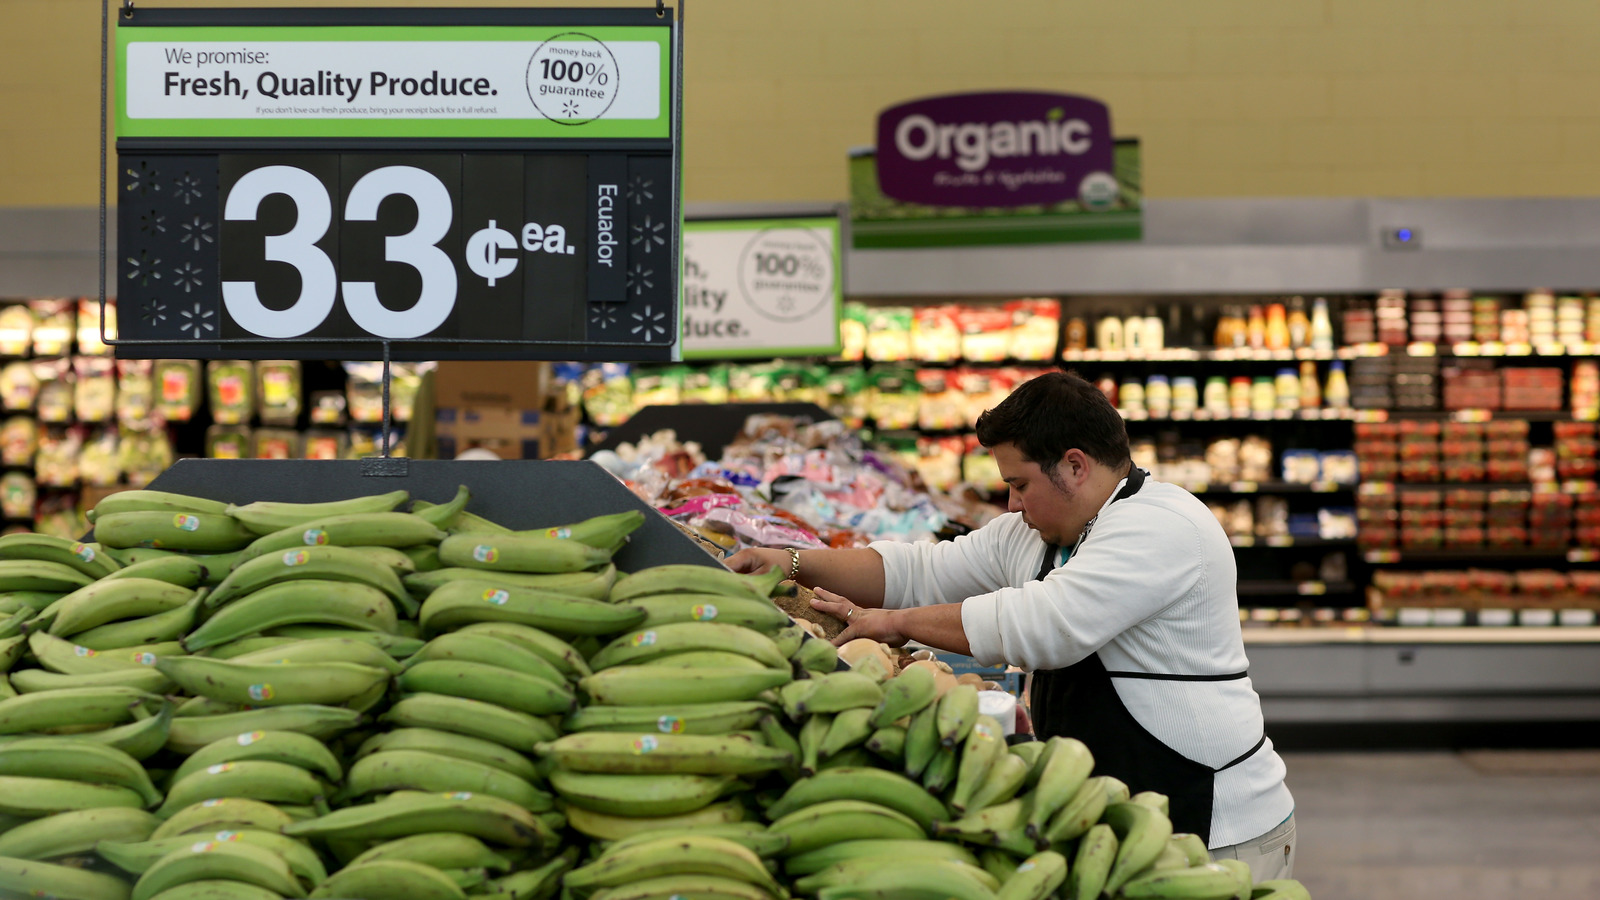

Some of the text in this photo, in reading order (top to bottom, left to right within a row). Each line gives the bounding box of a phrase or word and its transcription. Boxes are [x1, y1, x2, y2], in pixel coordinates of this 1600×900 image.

[164, 48, 270, 69] We promise:
[548, 47, 602, 59] money back
[540, 58, 609, 86] 100%
[164, 70, 498, 103] Fresh, Quality Produce.
[539, 84, 605, 99] guarantee
[261, 108, 274, 116] you
[275, 106, 292, 114] don't
[293, 106, 310, 114] love
[321, 106, 338, 114] fresh
[369, 106, 387, 116] bring
[388, 108, 404, 116] your
[404, 106, 428, 116] receipt
[429, 106, 445, 114] back
[446, 106, 455, 114] for
[462, 106, 473, 114] full
[473, 106, 498, 114] refund.
[894, 109, 1092, 171] Organic
[597, 184, 618, 267] Ecuador
[755, 252, 826, 281] 100%
[683, 286, 729, 313] lity
[682, 315, 750, 338] duce.
